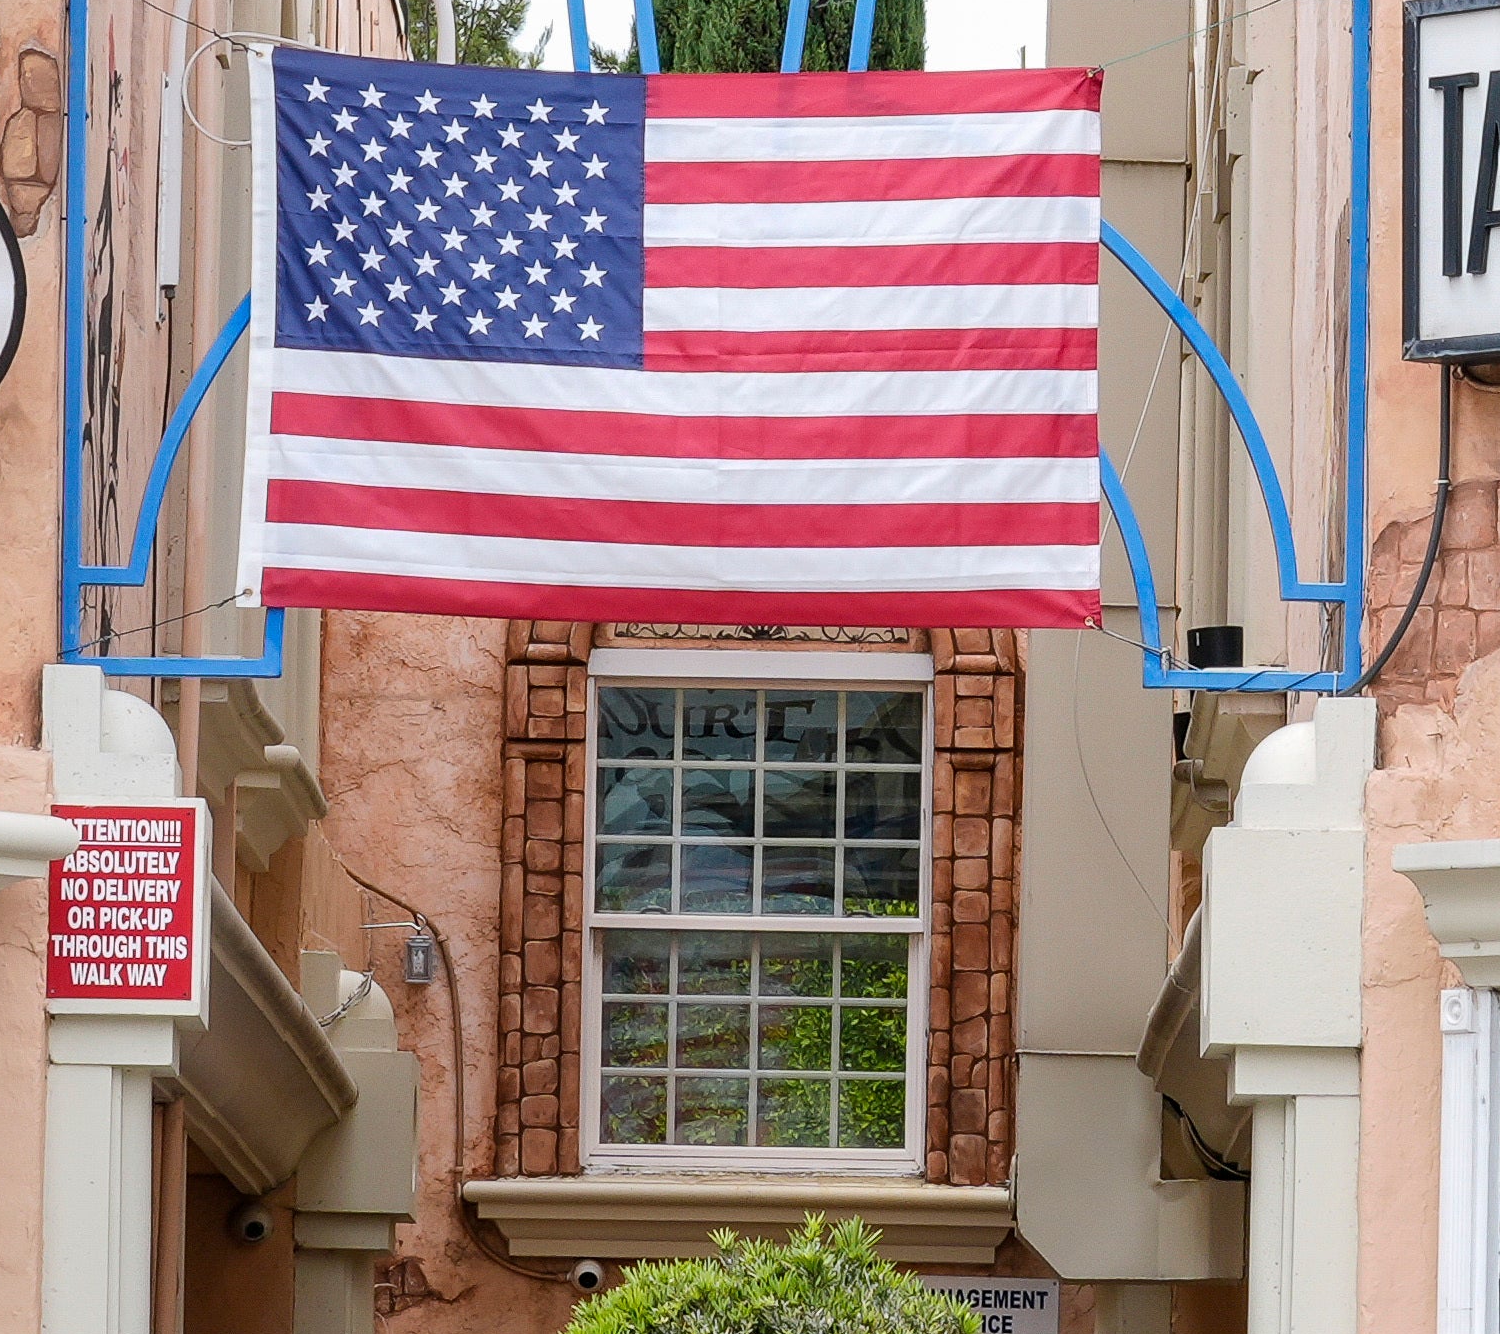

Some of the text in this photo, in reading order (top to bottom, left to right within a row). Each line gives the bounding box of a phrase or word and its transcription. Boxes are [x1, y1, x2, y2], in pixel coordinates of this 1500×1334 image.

[66, 818, 182, 843] TTENTION!!!
[63, 850, 180, 874] ABSOLUTELY
[61, 878, 181, 902] NO DELIVERY
[68, 906, 173, 931] OR PICK-UP
[52, 935, 187, 960] THROUGH THIS
[70, 963, 167, 986] WALK WAY
[930, 1288, 1049, 1310] AGEMENT
